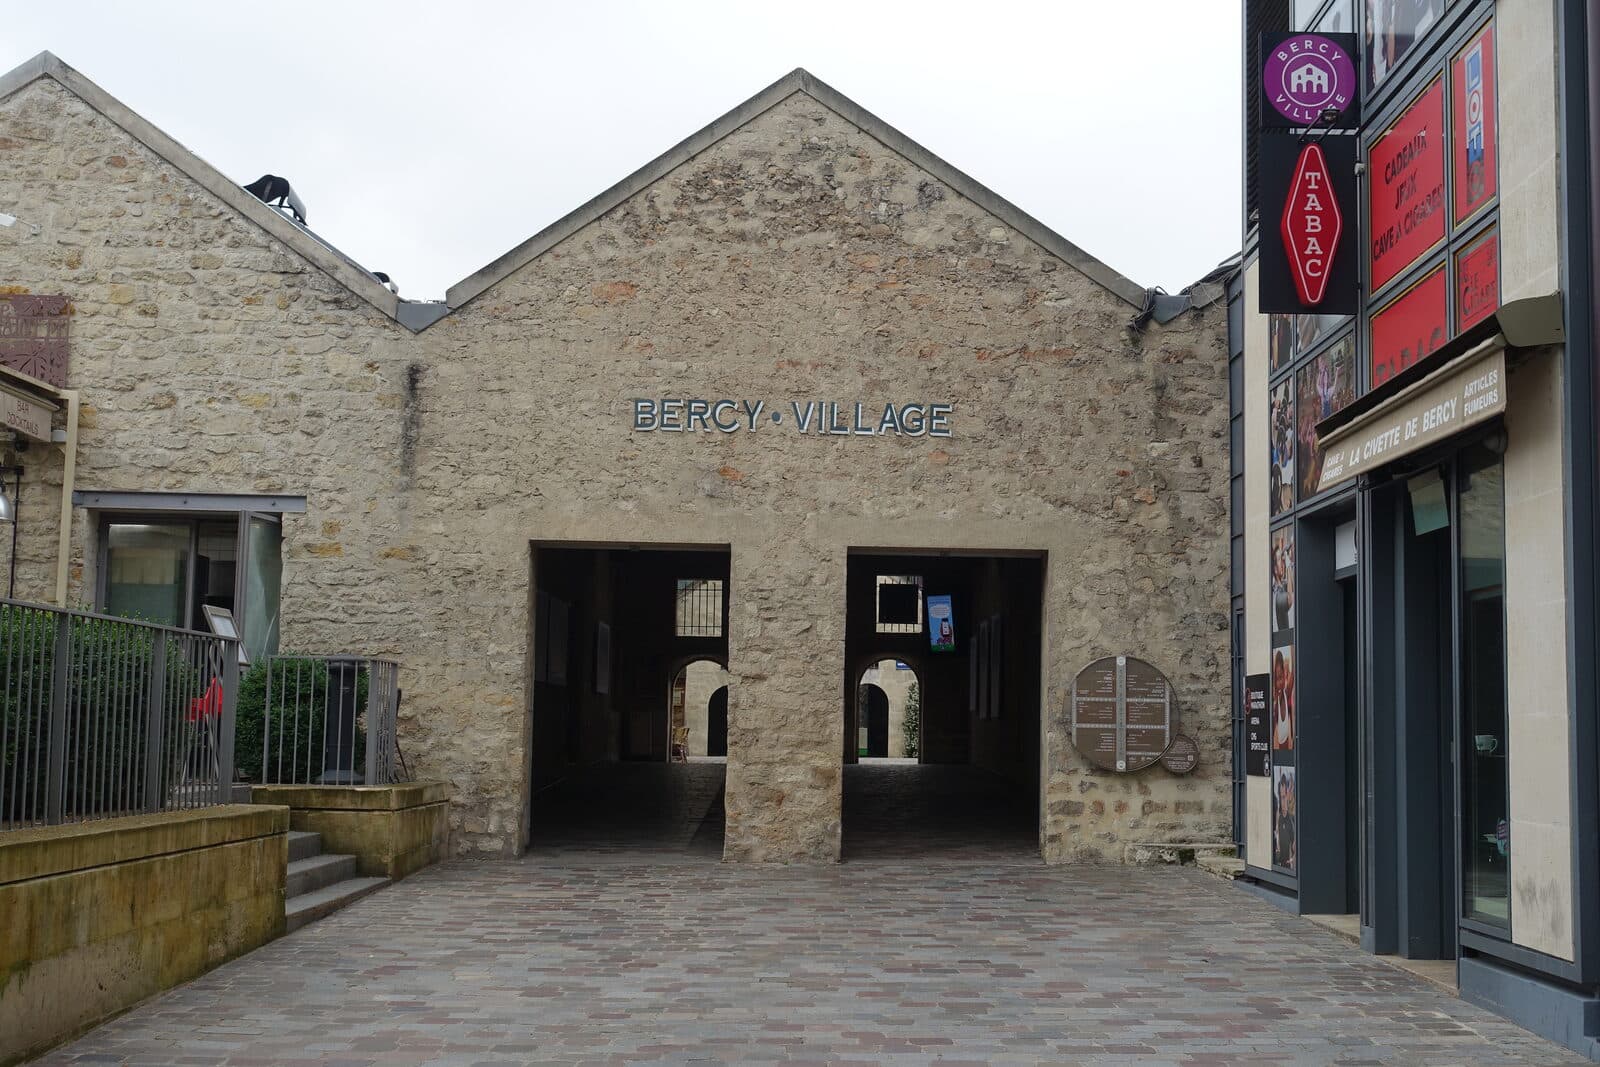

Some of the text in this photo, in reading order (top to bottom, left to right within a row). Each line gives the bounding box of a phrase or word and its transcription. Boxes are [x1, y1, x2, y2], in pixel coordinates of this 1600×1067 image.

[1277, 40, 1342, 61] BERCY
[1385, 126, 1427, 185] CADEAUX
[1304, 172, 1323, 277] TABAC
[1373, 226, 1394, 261] CAVE
[1464, 369, 1498, 399] ARTICLES
[633, 399, 953, 438] BERCY VILLAGE
[1464, 389, 1499, 417] FUMEURS
[1349, 397, 1458, 467] LA CIVETTE DE BERCY
